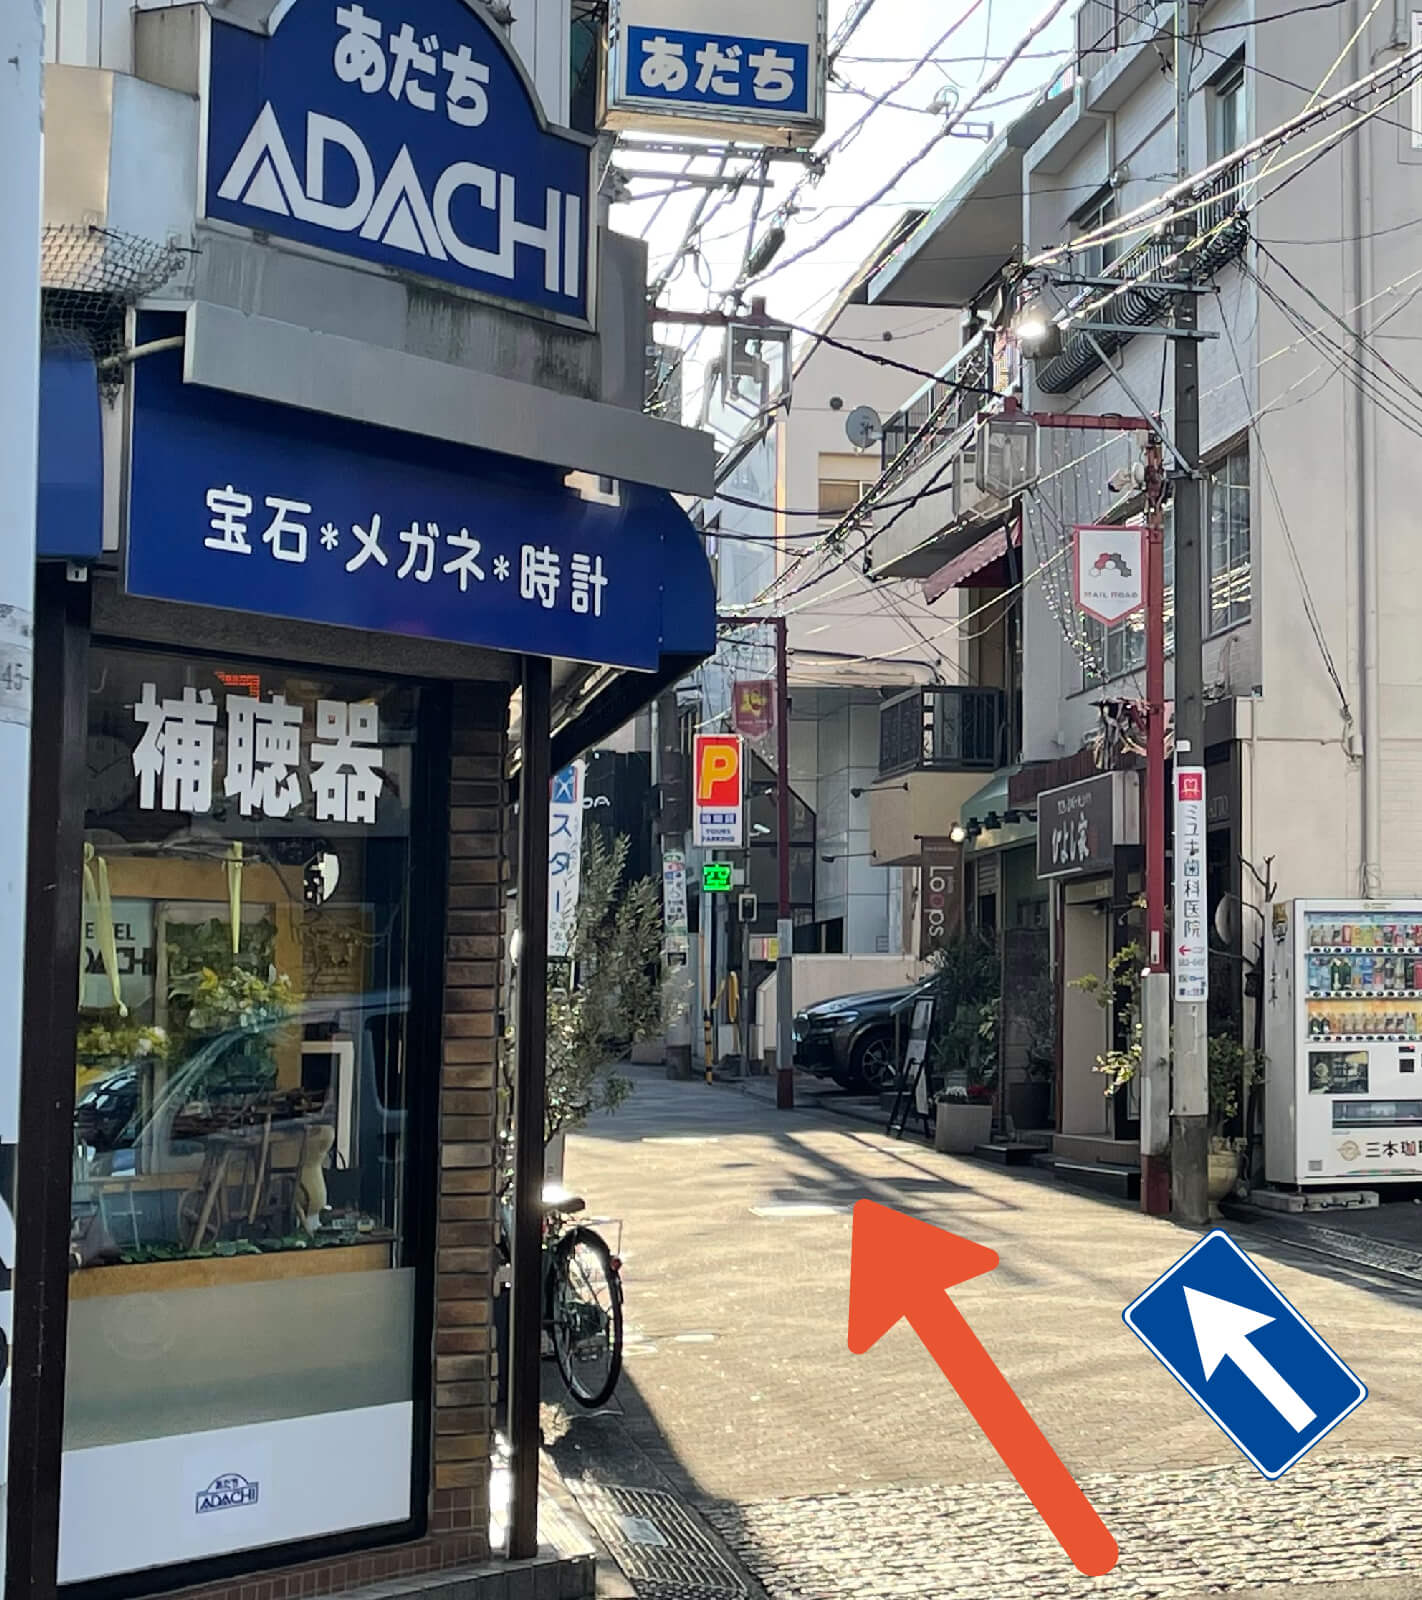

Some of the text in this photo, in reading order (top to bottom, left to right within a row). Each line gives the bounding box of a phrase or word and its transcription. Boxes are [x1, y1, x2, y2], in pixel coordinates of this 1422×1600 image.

[334, 4, 490, 127] あだち
[640, 36, 795, 101] あだち
[217, 99, 580, 298] ADACHI
[132, 682, 384, 824] 補聴器
[698, 744, 738, 800] P
[703, 863, 730, 891] 空
[924, 866, 954, 936] Loops
